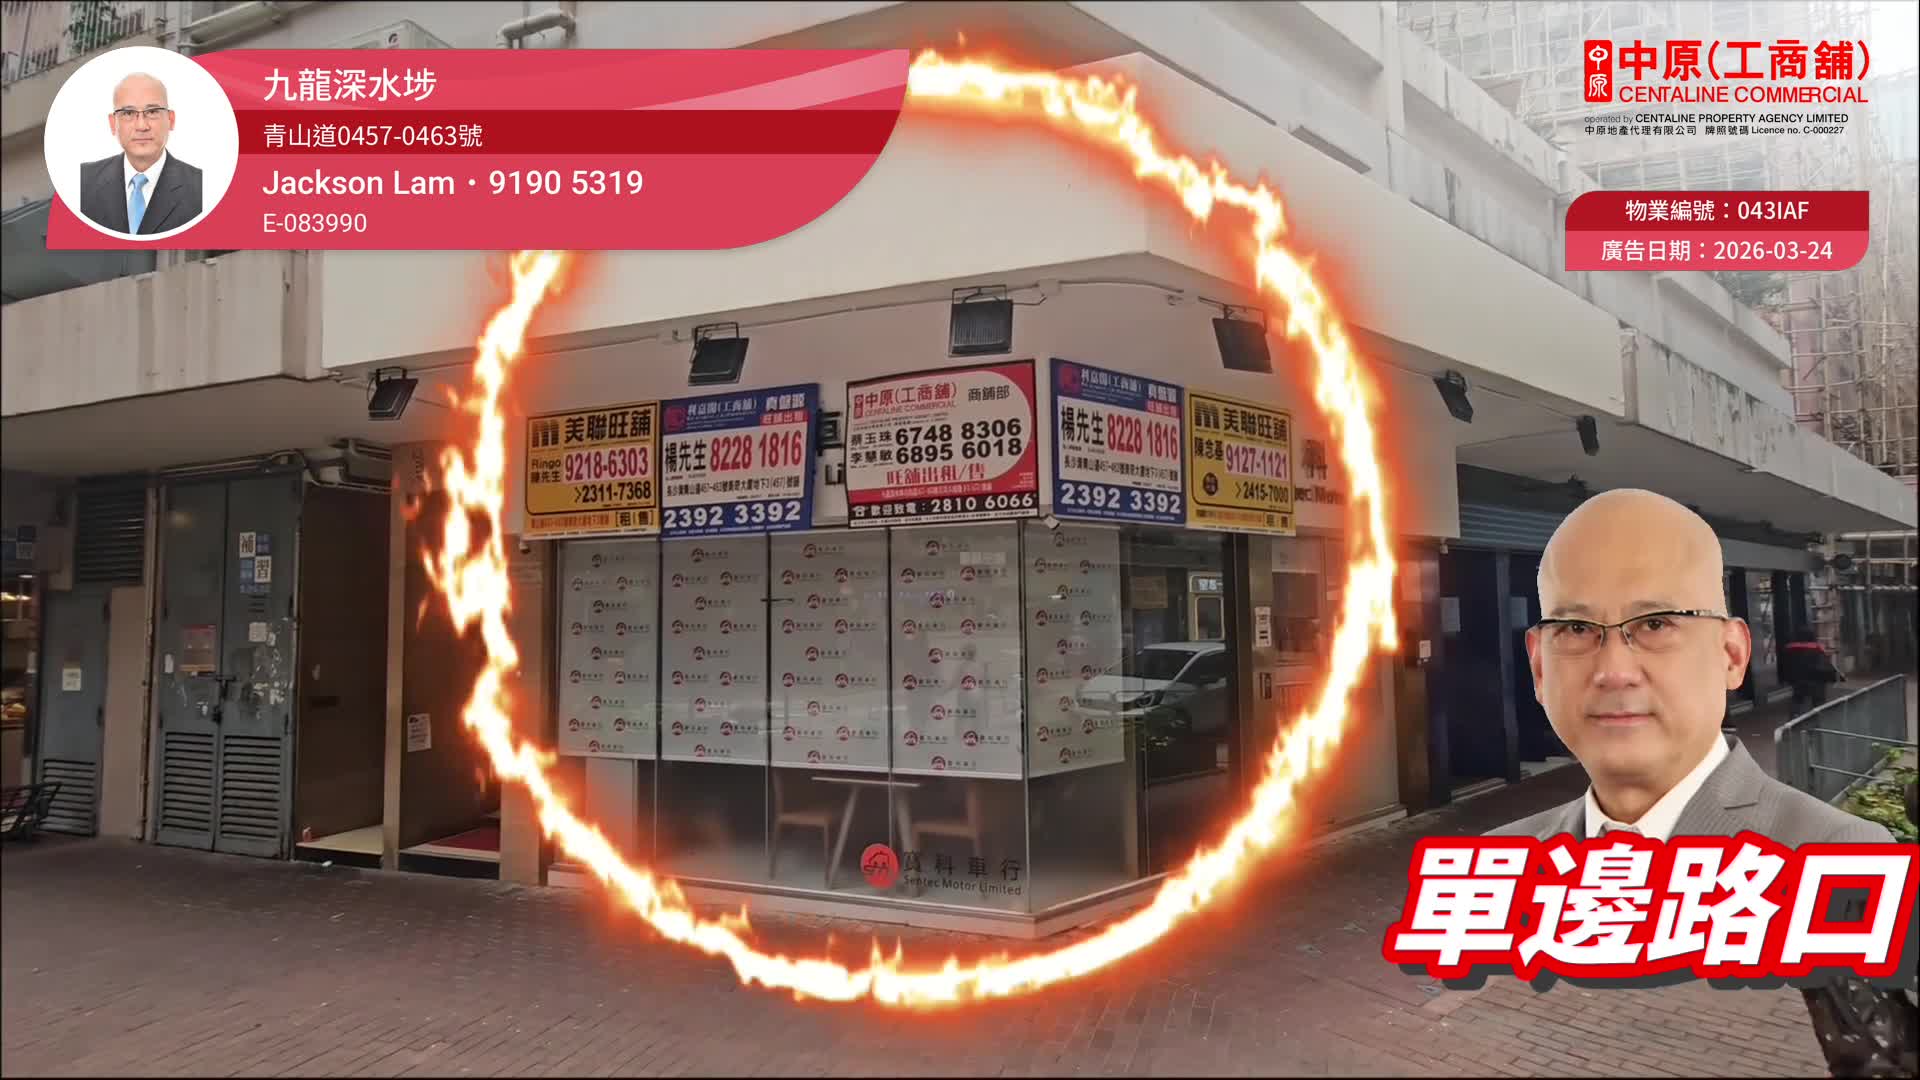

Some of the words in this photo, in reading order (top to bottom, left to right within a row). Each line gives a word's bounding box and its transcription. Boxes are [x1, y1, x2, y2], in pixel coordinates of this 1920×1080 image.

[865, 382, 957, 407] 中原(工商舖)
[565, 408, 651, 443] 美聯旺舖
[896, 424, 952, 445] 6748
[961, 418, 1021, 438] 8306
[1061, 406, 1104, 446] 楊先生
[1107, 413, 1143, 453] 8228
[1146, 420, 1177, 461] 1816
[531, 457, 562, 469] Ringo
[565, 447, 648, 481] 9218-6303
[665, 440, 707, 472] 楊先生
[710, 436, 752, 472] 8228
[759, 430, 801, 468] 1816
[896, 443, 953, 464] 6895
[962, 438, 1022, 459] 6018
[1226, 444, 1288, 479] 9127-1121
[582, 481, 651, 503] 2311-7368
[931, 497, 976, 512] 2810
[985, 494, 1033, 509] 6066
[1061, 483, 1120, 508] 2392
[1130, 490, 1180, 513] 3392
[664, 506, 724, 528] 2392
[734, 501, 801, 524] 3392
[942, 879, 975, 891] Motor
[979, 883, 1022, 896] Limited
